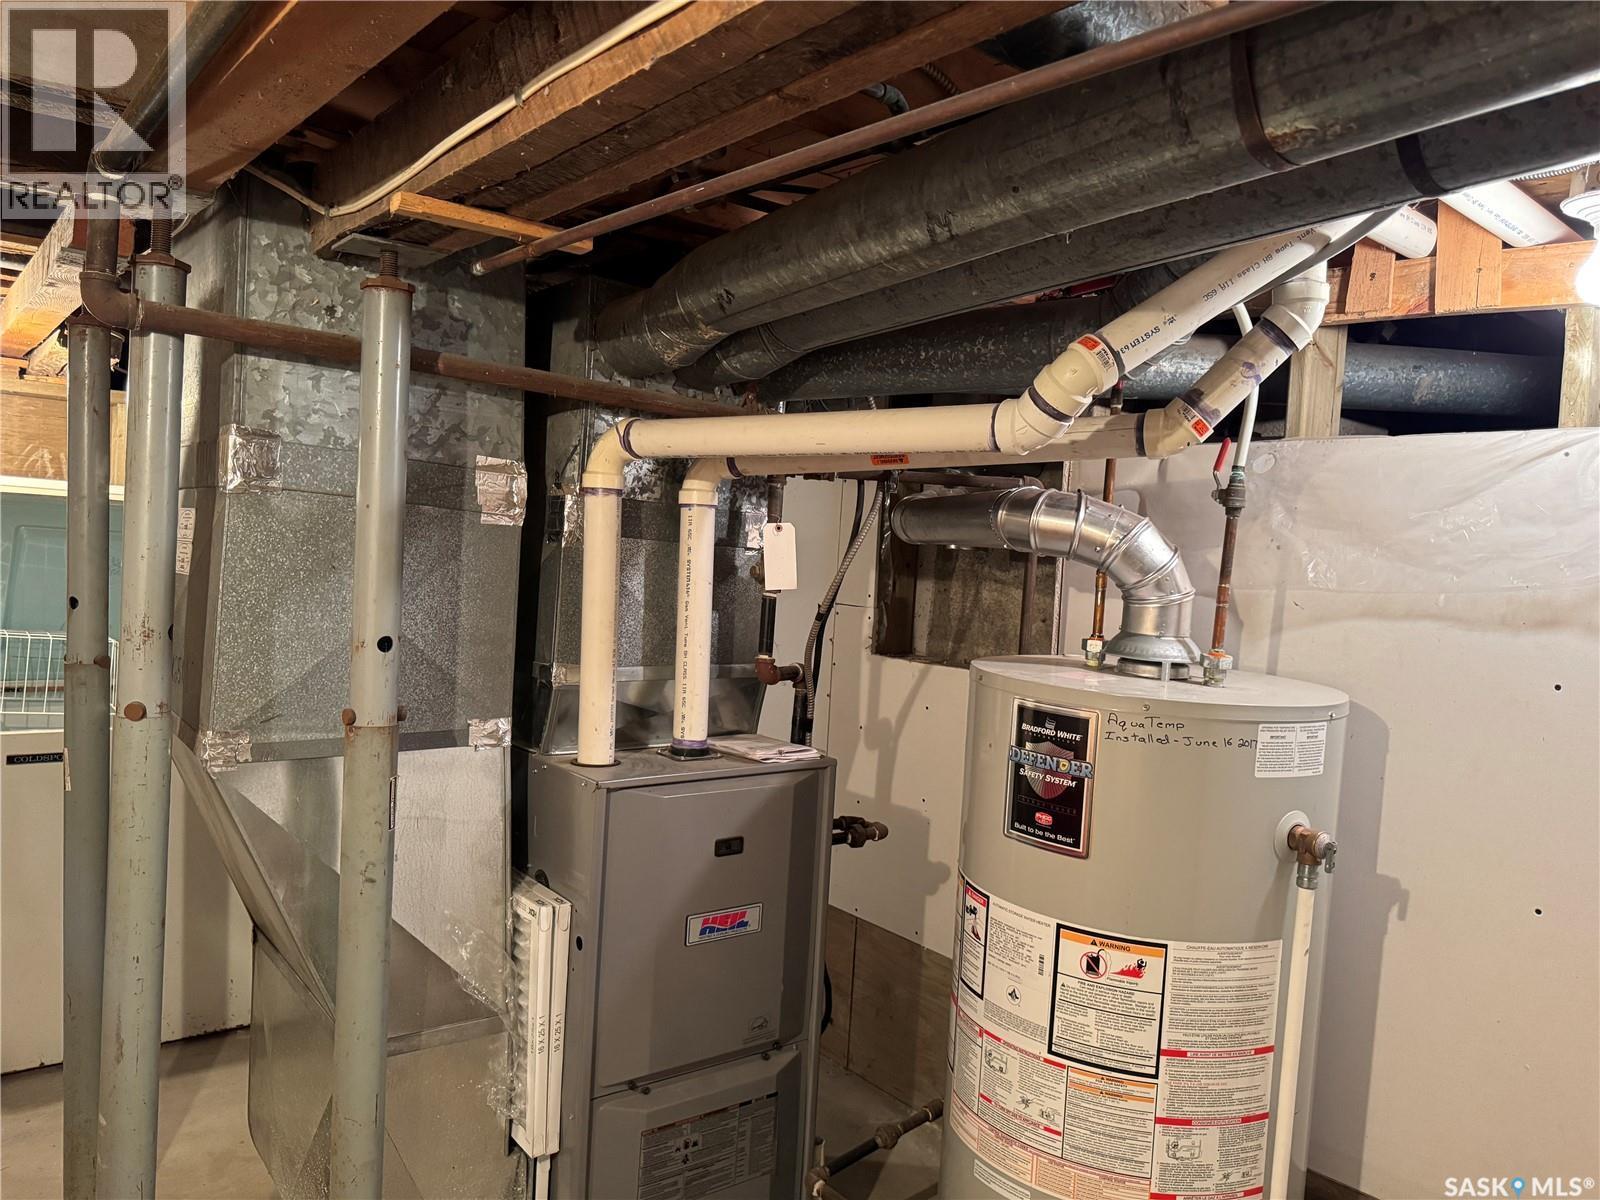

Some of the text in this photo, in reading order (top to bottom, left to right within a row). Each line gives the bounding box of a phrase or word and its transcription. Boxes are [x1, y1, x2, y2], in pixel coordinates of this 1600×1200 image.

[1130, 325, 1161, 348] SYSTEM
[1021, 722, 1056, 737] BRADFORD
[1057, 730, 1082, 741] WHITE
[1104, 731, 1169, 745] Installed
[1182, 736, 1218, 747] June
[1223, 737, 1233, 747] 16
[1237, 738, 1258, 750] 2017
[14, 754, 63, 763] COLDSPO
[1010, 746, 1094, 779] DEFENDER
[1014, 821, 1027, 831] Built
[1035, 828, 1044, 836] be
[1044, 831, 1056, 840] the
[1057, 834, 1074, 844] Best
[1098, 940, 1131, 952] WARNING
